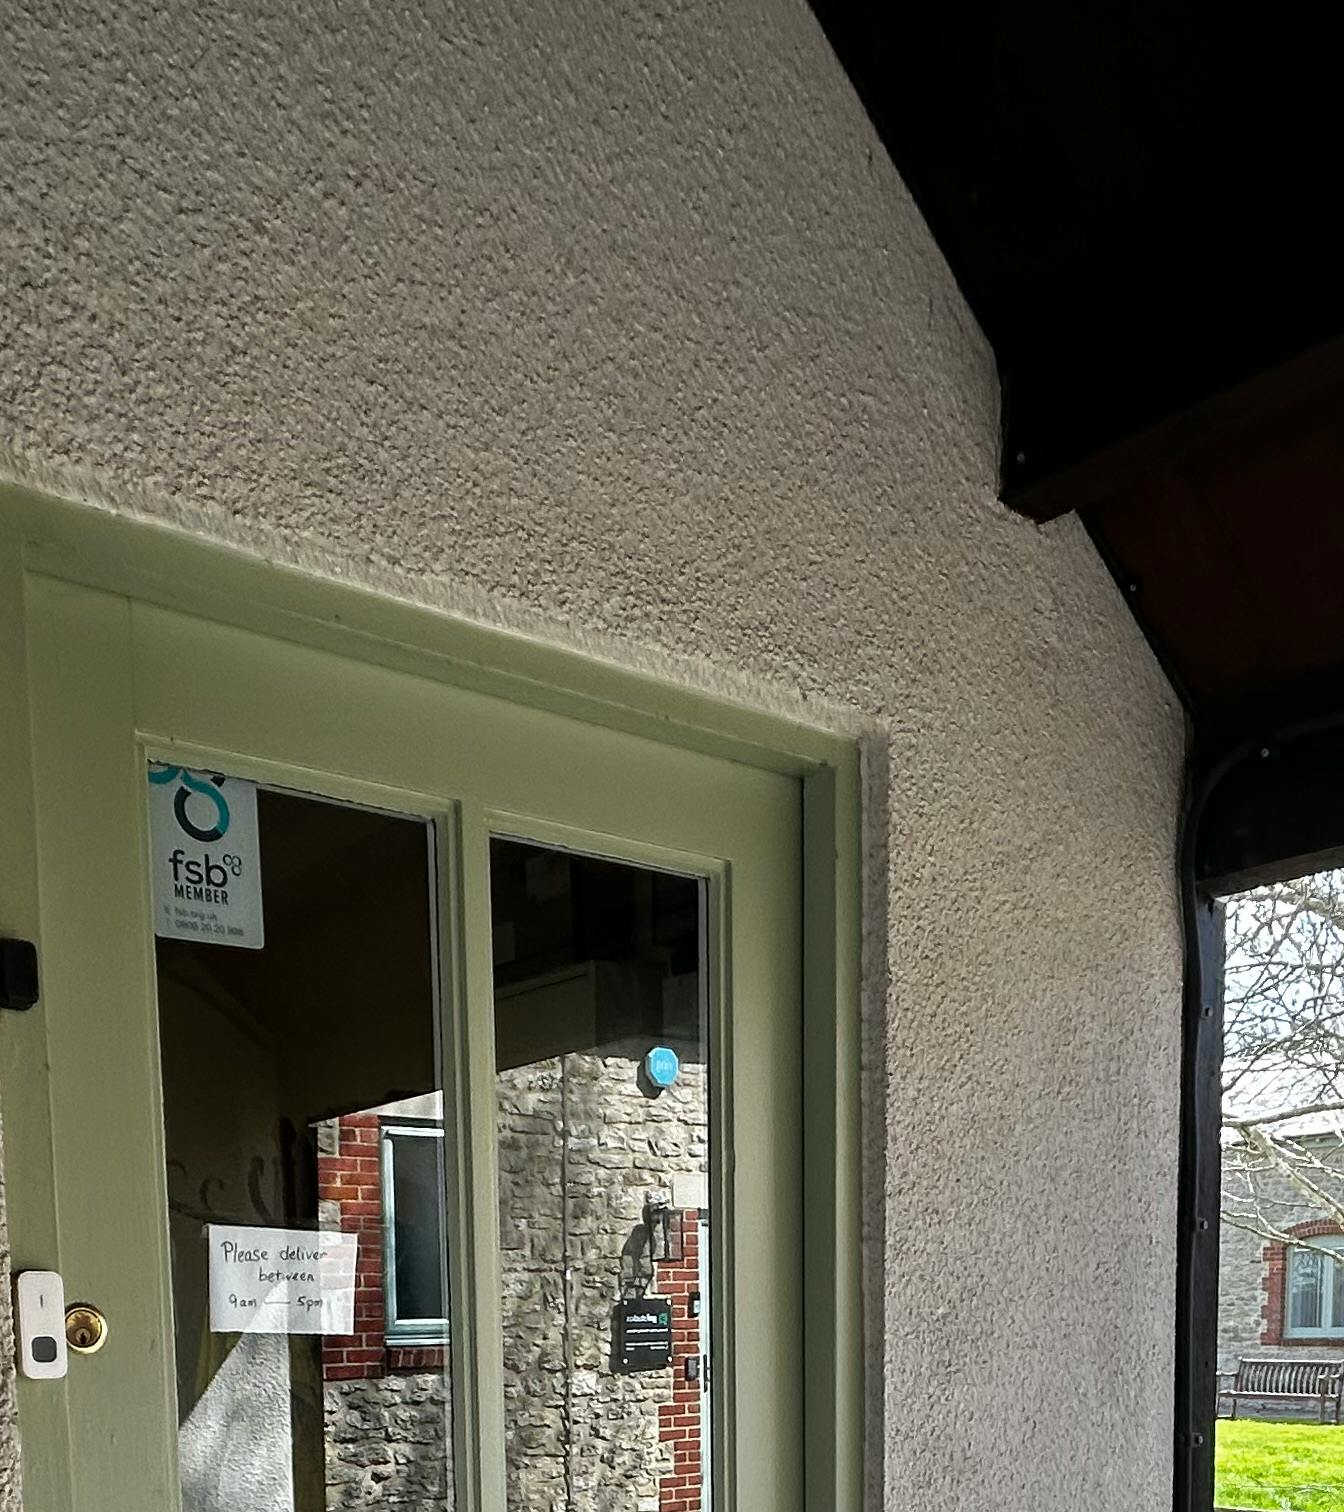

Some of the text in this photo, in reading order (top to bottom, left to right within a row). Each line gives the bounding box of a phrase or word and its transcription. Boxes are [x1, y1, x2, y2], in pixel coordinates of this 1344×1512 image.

[169, 849, 228, 888] fsb
[174, 883, 230, 906] MEMBER
[220, 1240, 328, 1264] Please deliver
[258, 1267, 315, 1282] between
[296, 1296, 323, 1312] 5pm
